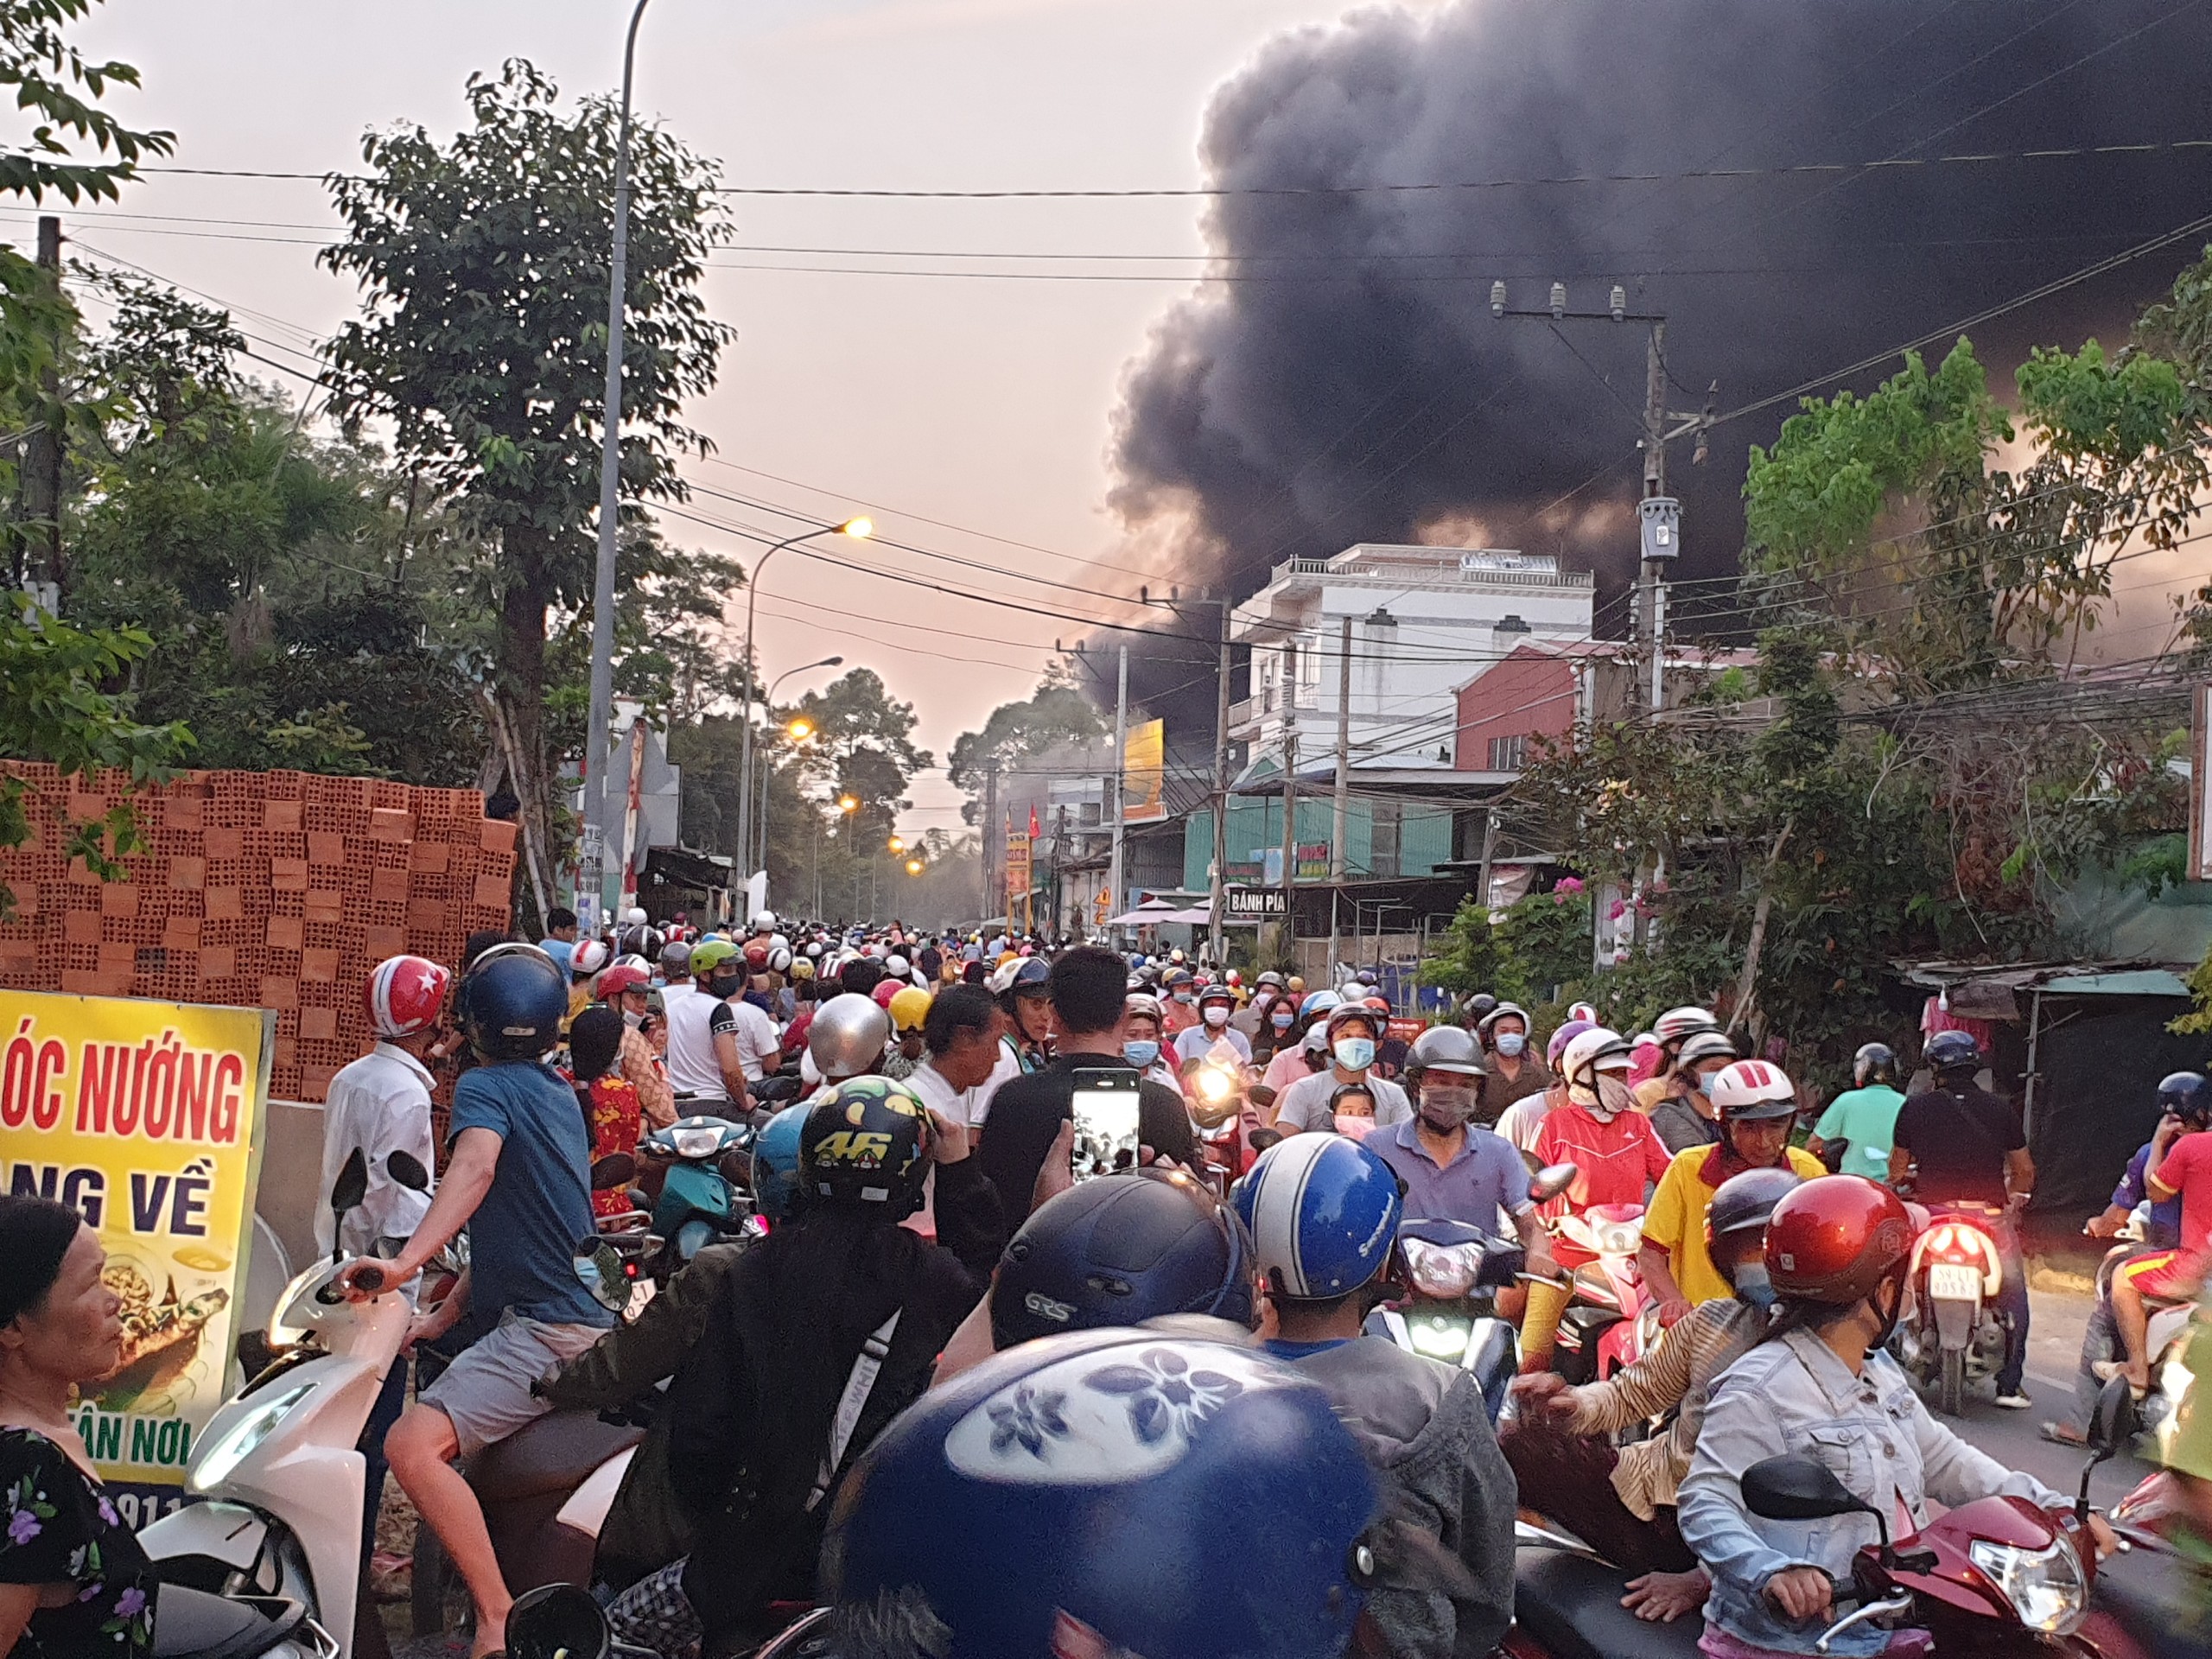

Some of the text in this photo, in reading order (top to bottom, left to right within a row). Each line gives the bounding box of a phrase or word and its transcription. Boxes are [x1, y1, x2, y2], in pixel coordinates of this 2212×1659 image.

[1231, 890, 1285, 912] BÁNH PÍA
[1, 1019, 243, 1143] ÓC NƯỚNG
[131, 1158, 213, 1236] VỀ
[67, 1406, 192, 1465] ÂN NƠI
